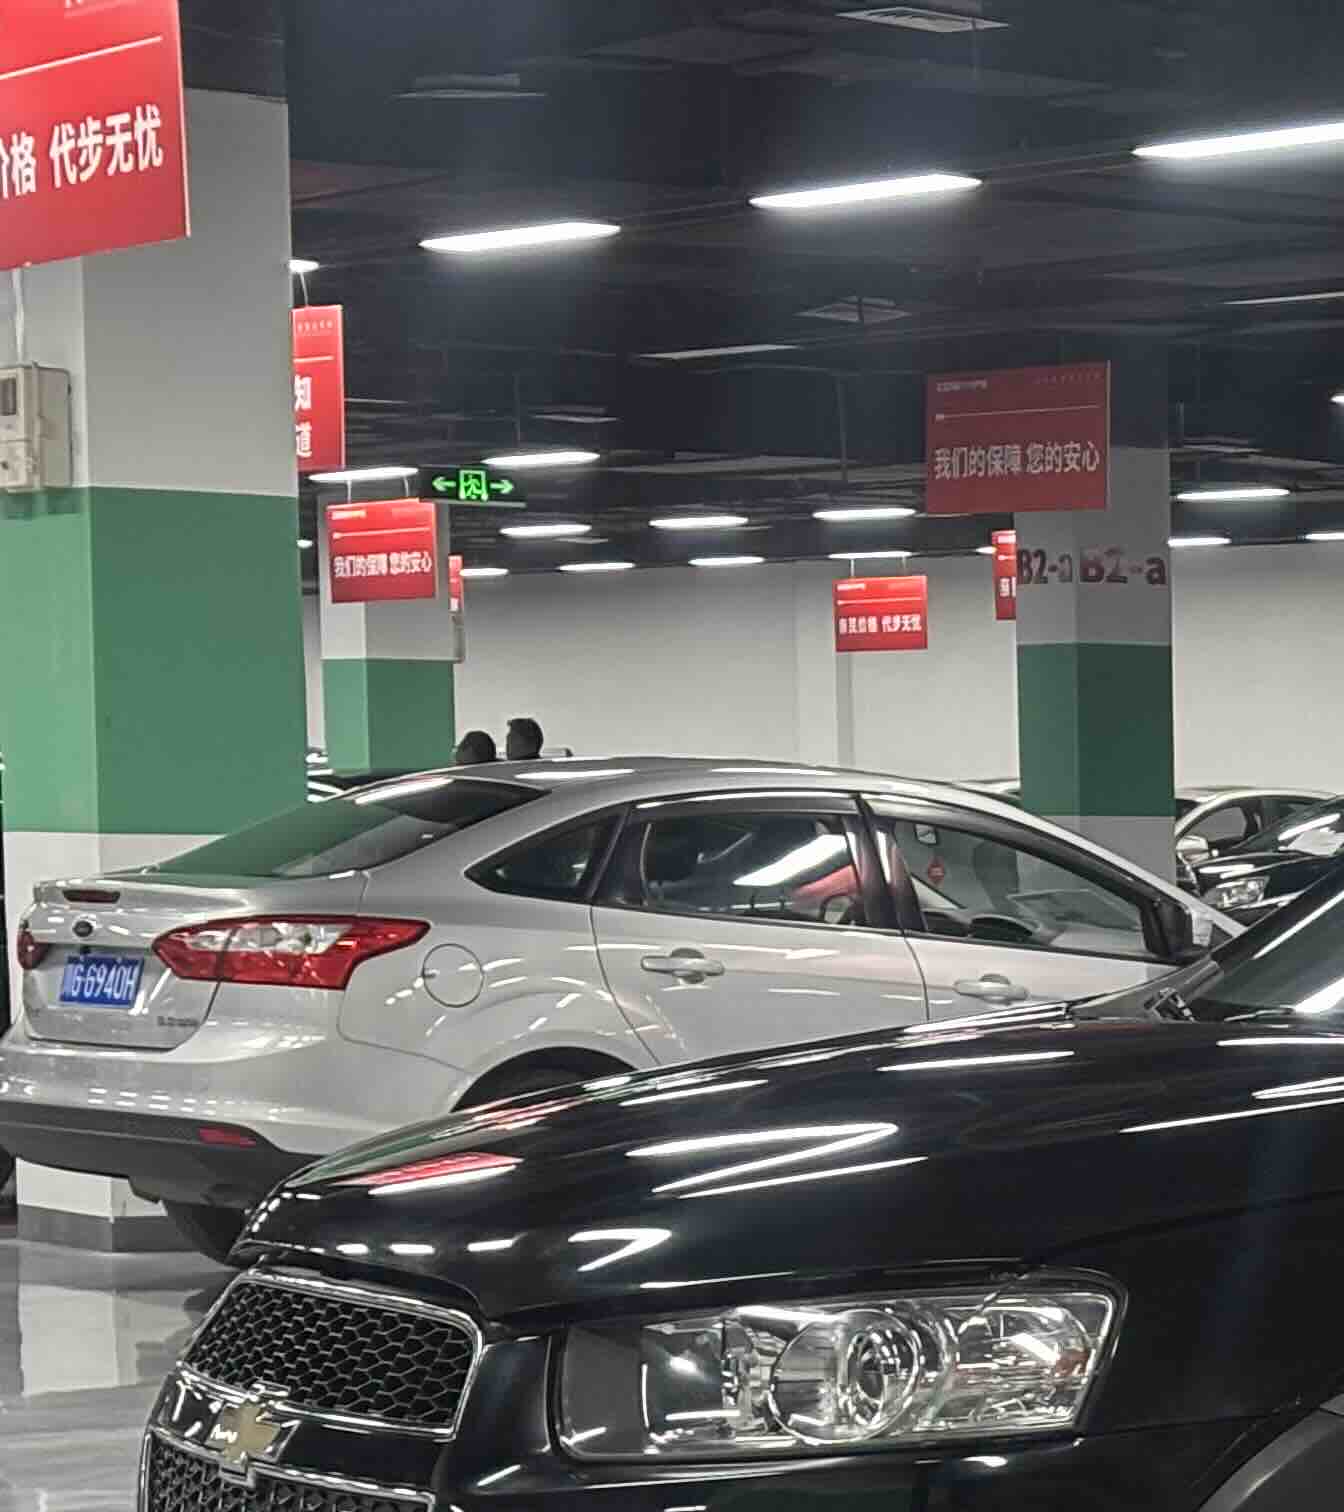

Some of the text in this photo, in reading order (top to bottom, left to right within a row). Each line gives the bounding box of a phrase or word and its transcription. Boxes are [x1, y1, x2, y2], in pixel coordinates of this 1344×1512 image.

[49, 103, 163, 188] 代步无忧
[934, 440, 1100, 480] 我们的保障 您的安心
[1079, 546, 1167, 585] B2-a
